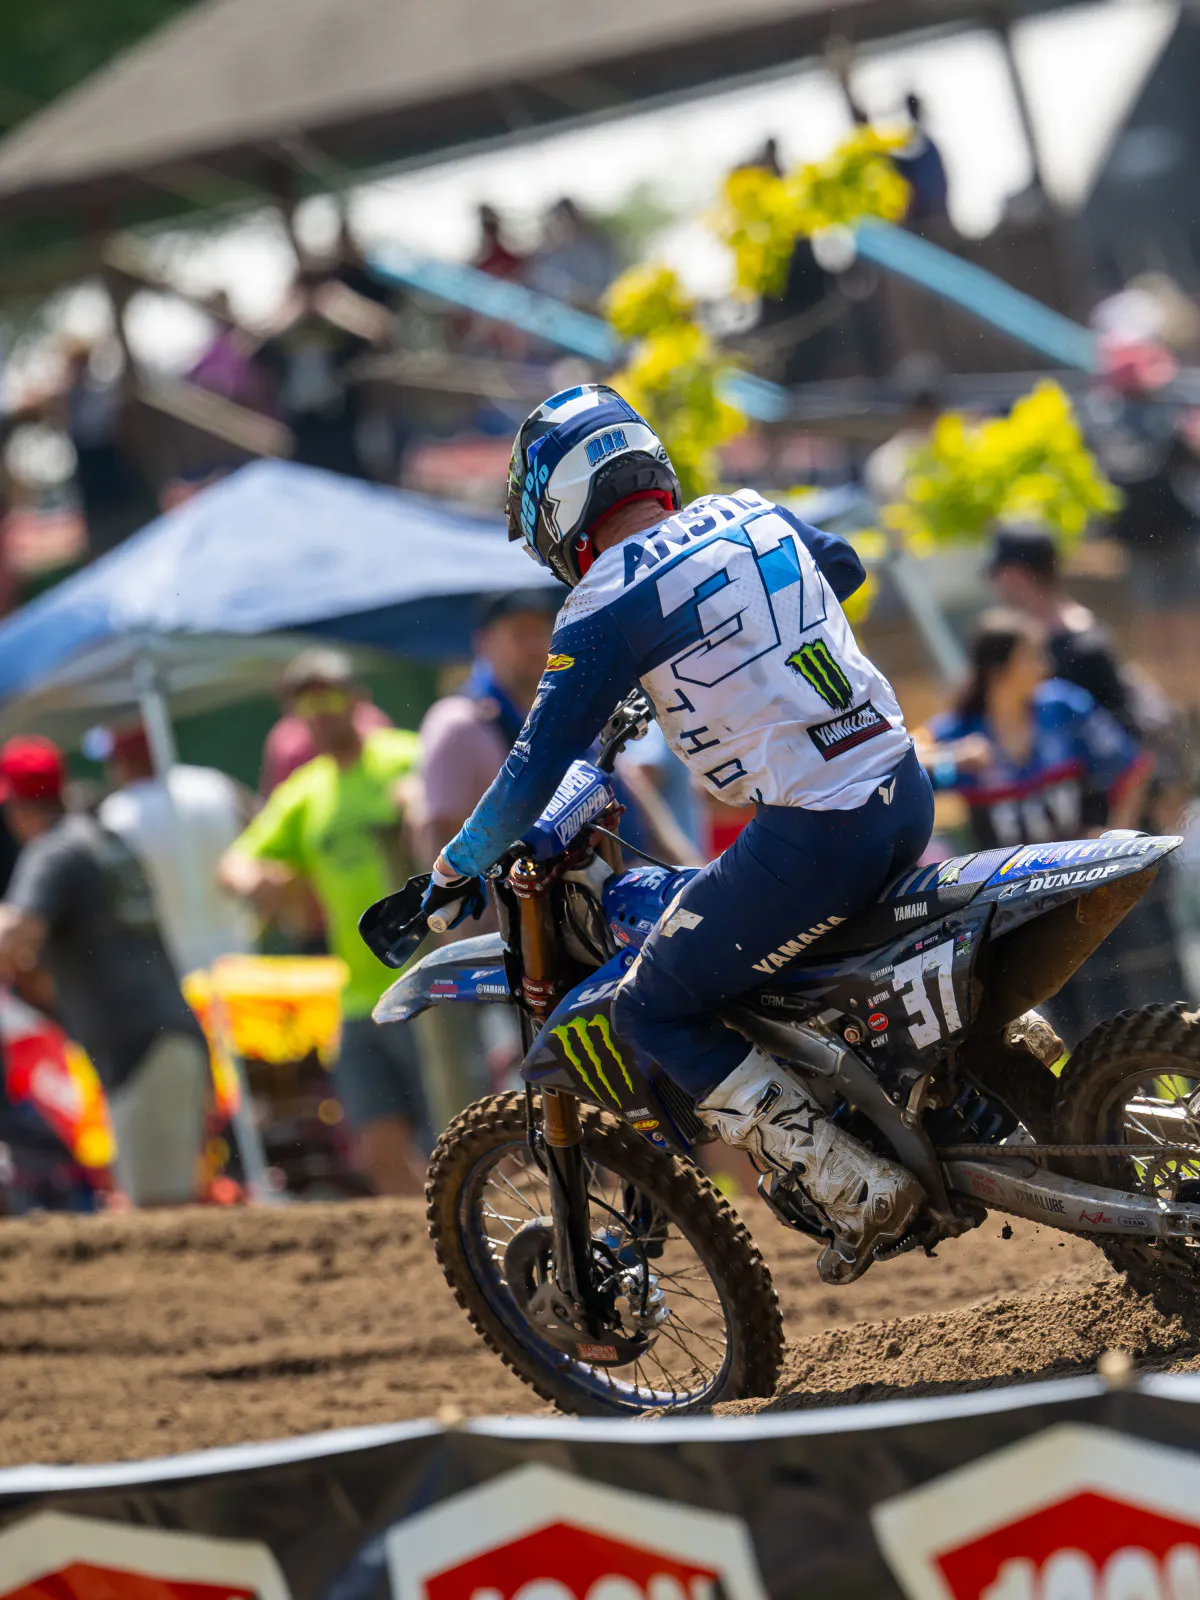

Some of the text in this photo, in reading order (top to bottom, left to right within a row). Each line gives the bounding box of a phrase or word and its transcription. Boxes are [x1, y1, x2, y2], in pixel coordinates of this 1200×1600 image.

[585, 429, 628, 466] MAX
[655, 513, 828, 688] 37
[815, 707, 882, 747] YAMALUBE
[559, 787, 609, 843] PROTAPER
[1025, 864, 1120, 893] DUNLOP
[893, 901, 928, 922] YAMAHA
[752, 915, 848, 975] YAMAHA
[482, 984, 506, 995] YAMAHA
[875, 965, 894, 979] YAMAHA
[873, 990, 890, 1005] OPTIMA
[892, 939, 963, 1050] 37
